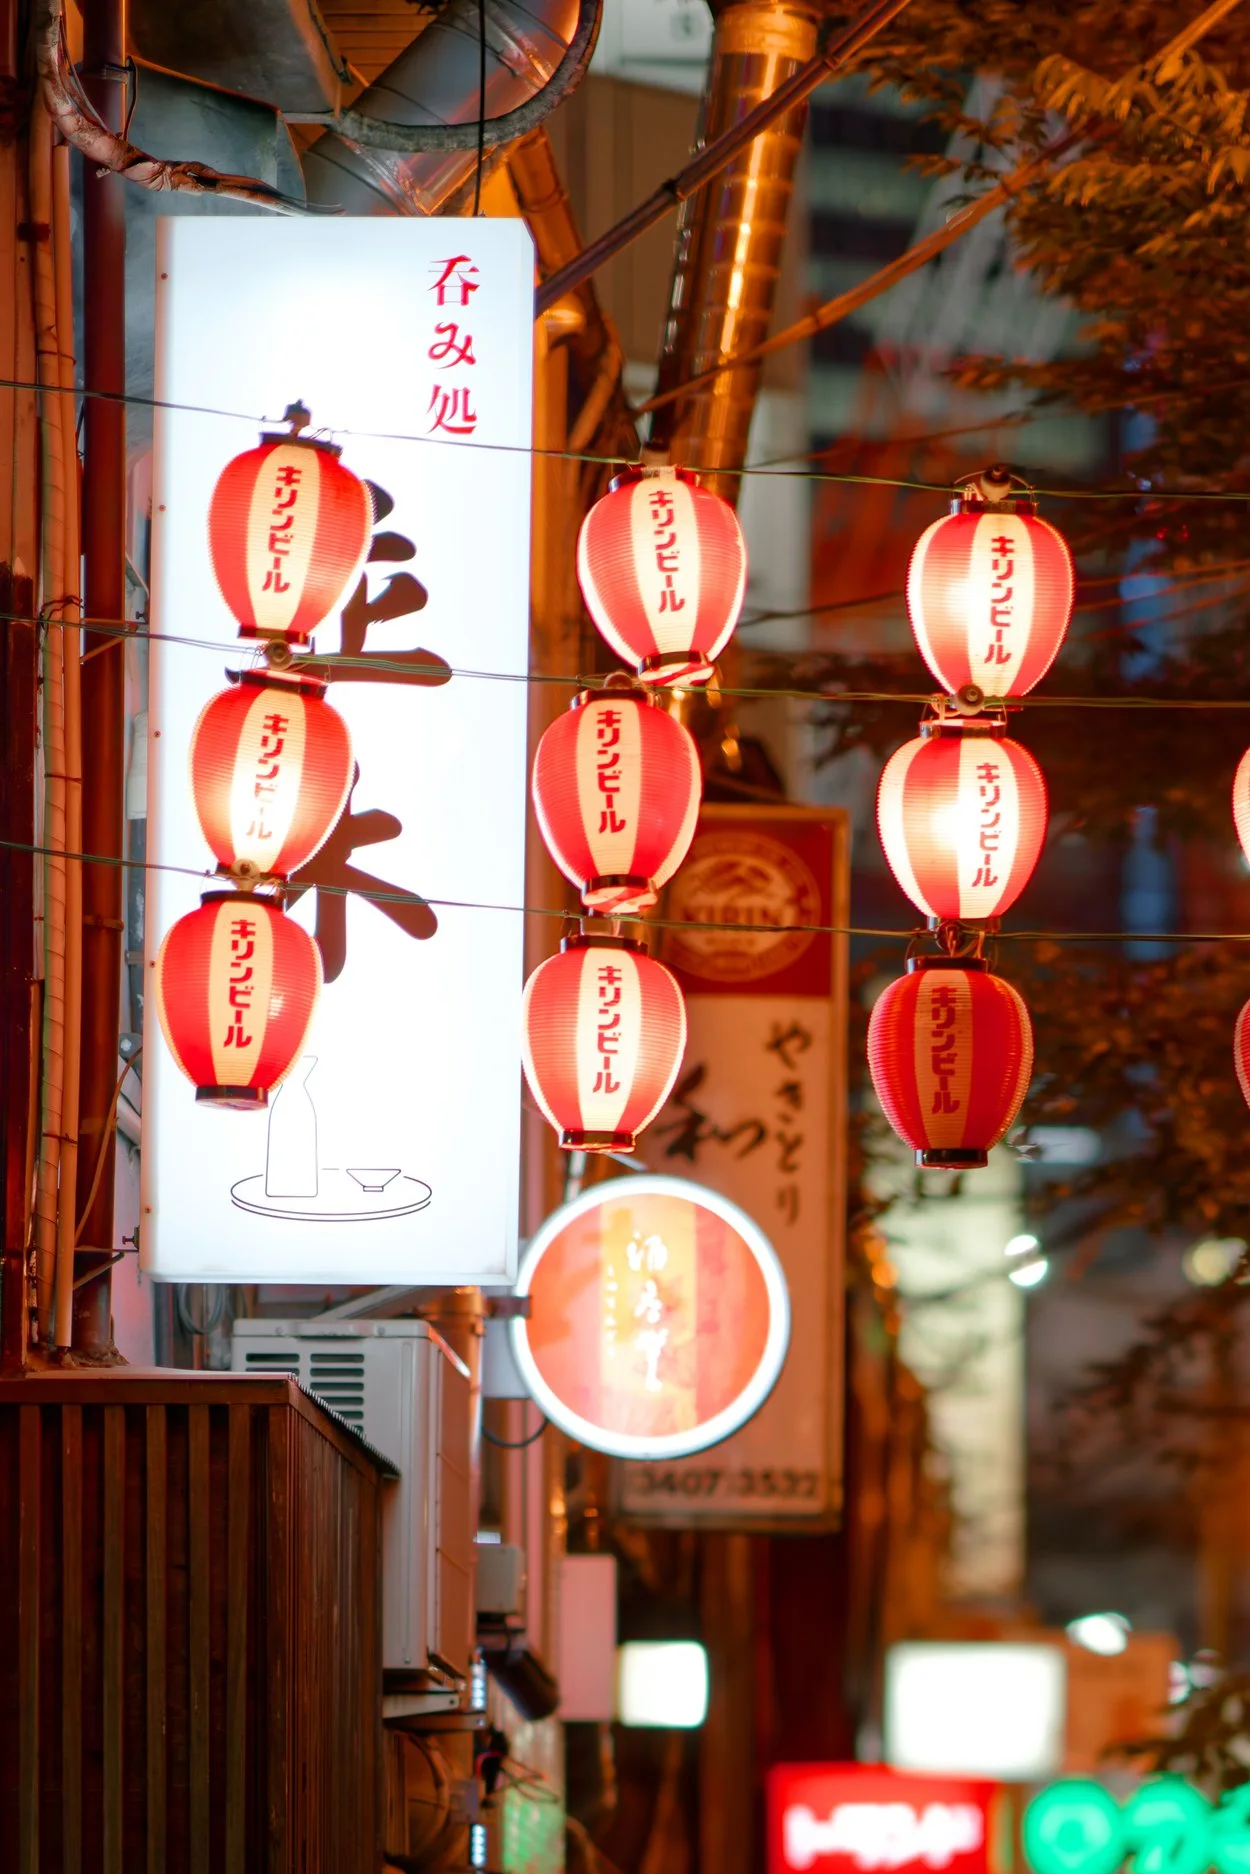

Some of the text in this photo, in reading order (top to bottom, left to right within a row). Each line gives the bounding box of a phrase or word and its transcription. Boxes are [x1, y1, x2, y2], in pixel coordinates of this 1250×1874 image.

[425, 254, 481, 436] 呑み処
[261, 464, 303, 595] キリンビール
[648, 489, 687, 614] キリンビール
[983, 534, 1014, 666] キリンビール
[245, 713, 291, 842] キリンビール
[595, 708, 629, 835] キリンビール
[971, 760, 1001, 889] キリンビール
[223, 918, 258, 1050] キリンビール
[592, 964, 626, 1095] キリンビール
[929, 986, 961, 1116] キリンビール
[764, 1019, 813, 1228] やきとり
